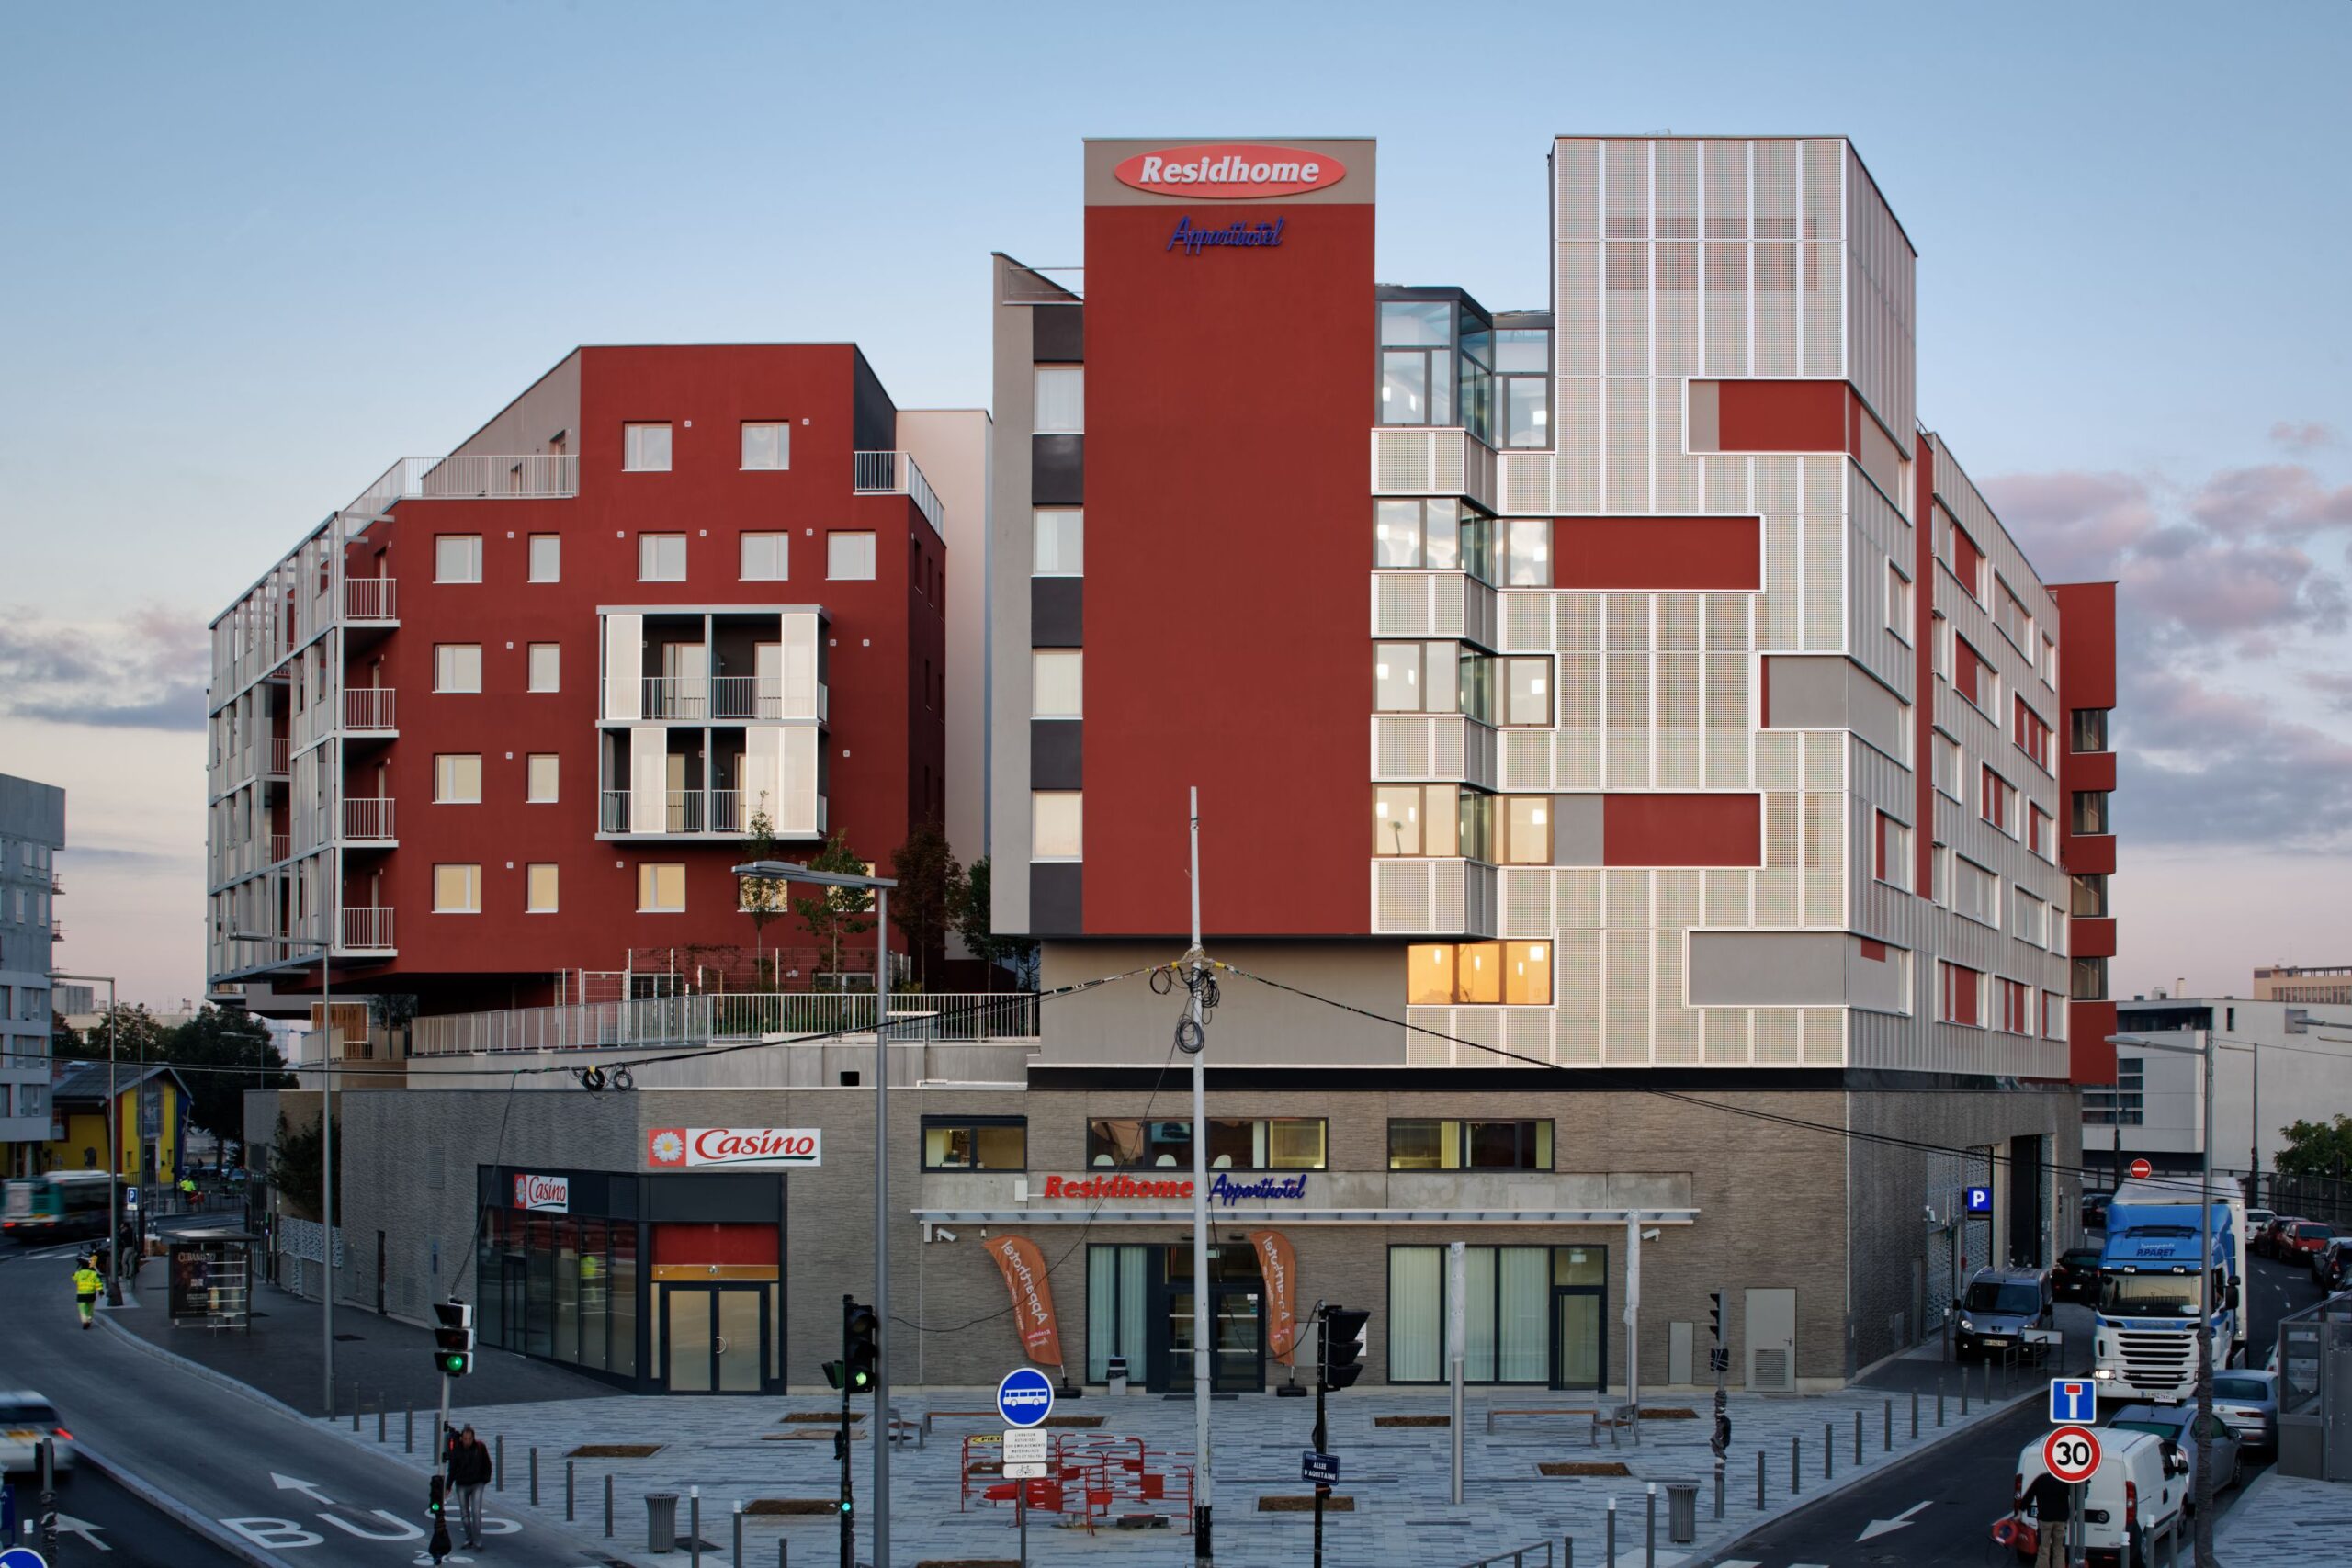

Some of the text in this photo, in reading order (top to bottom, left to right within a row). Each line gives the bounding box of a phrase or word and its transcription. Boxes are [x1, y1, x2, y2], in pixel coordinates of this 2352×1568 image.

[1139, 155, 1320, 184] Residhome
[1166, 216, 1286, 255] Apparthotel
[695, 1129, 815, 1160] Casino
[129, 1190, 135, 1201] P
[528, 1176, 567, 1204] Casino
[1044, 1173, 1308, 1206] Residhome Apparthotel
[1973, 1190, 1985, 1208] P
[2055, 1441, 2090, 1466] 30
[217, 1505, 524, 1549] BUS
